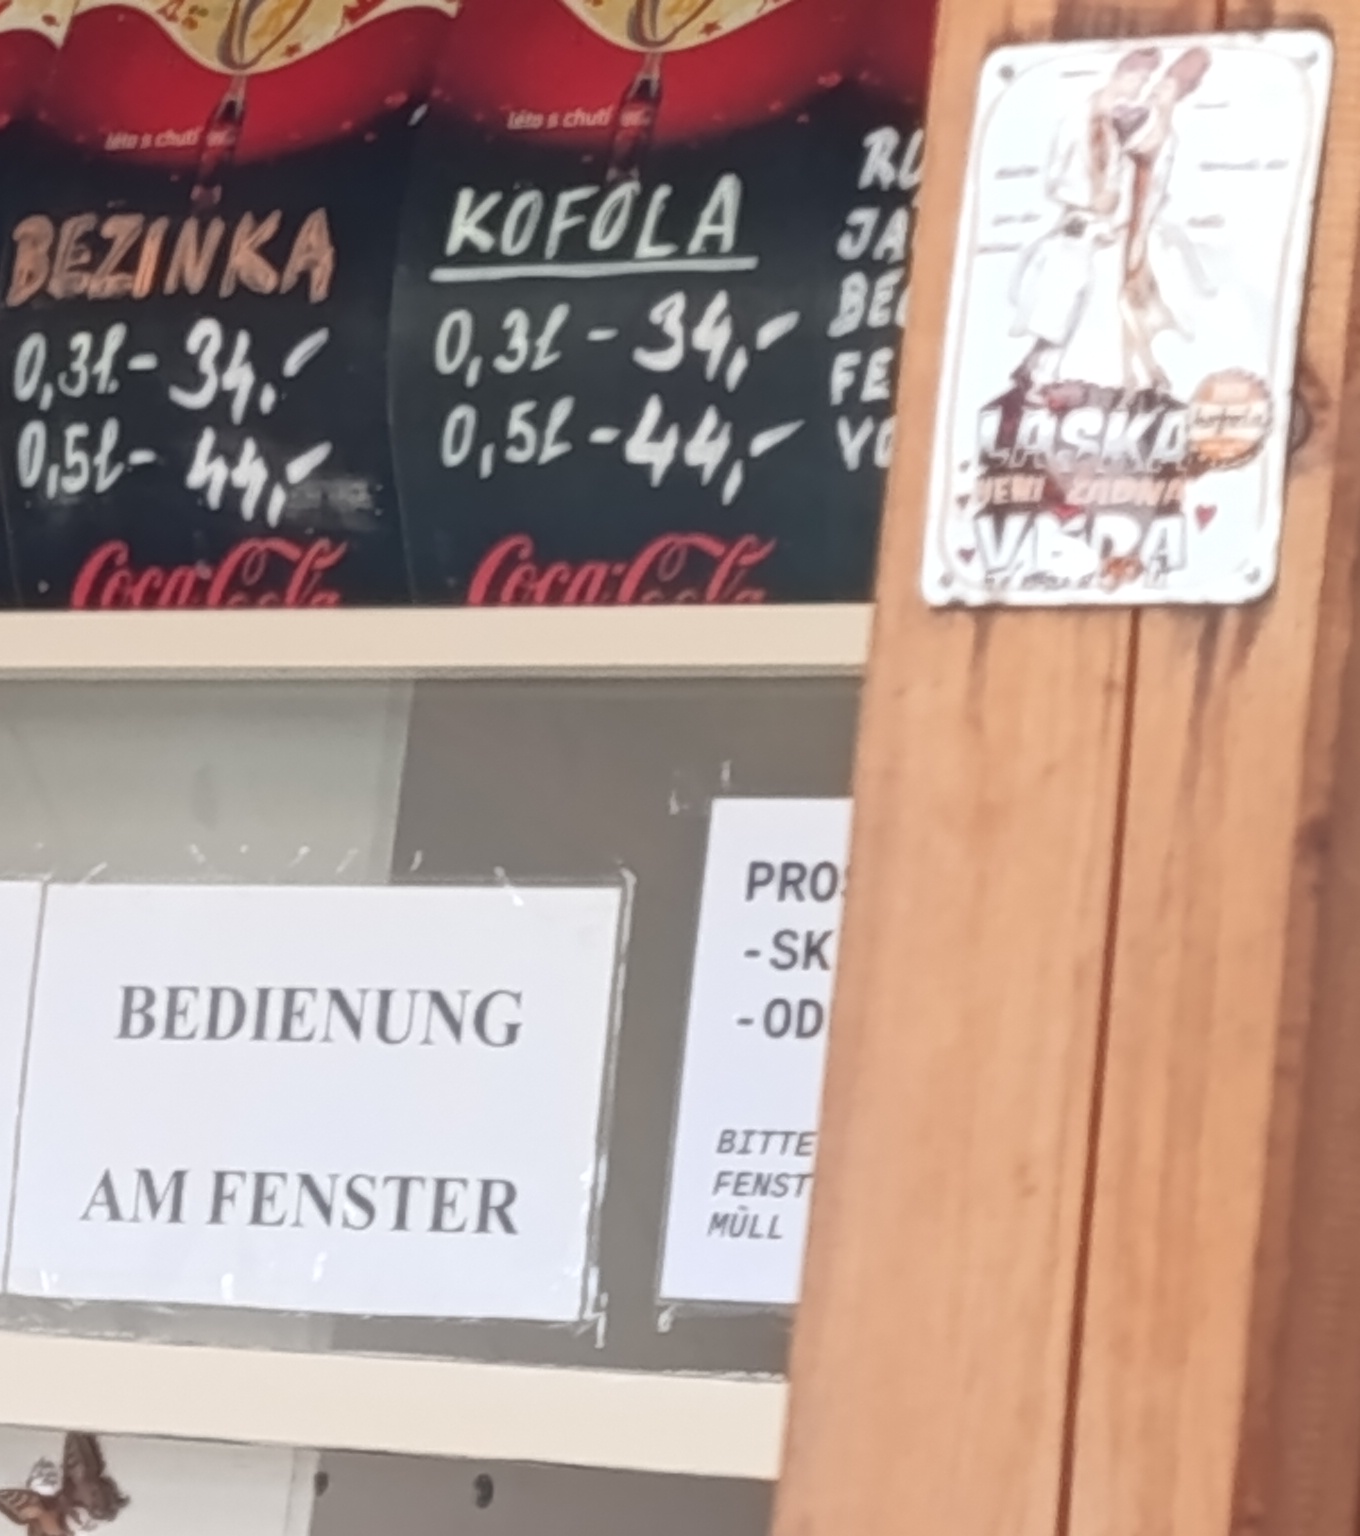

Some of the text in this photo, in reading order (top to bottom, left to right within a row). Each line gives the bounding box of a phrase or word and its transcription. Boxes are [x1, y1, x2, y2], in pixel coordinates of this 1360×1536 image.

[446, 172, 742, 261] KOFOLA
[8, 208, 335, 305] BEZINKA
[113, 983, 525, 1051] BEDIENUNG
[716, 1129, 817, 1156] BITTE
[79, 1168, 195, 1228] AM
[206, 1168, 520, 1236] FENSTER
[712, 1172, 814, 1197] FENST
[707, 1206, 784, 1239] MÜLL
